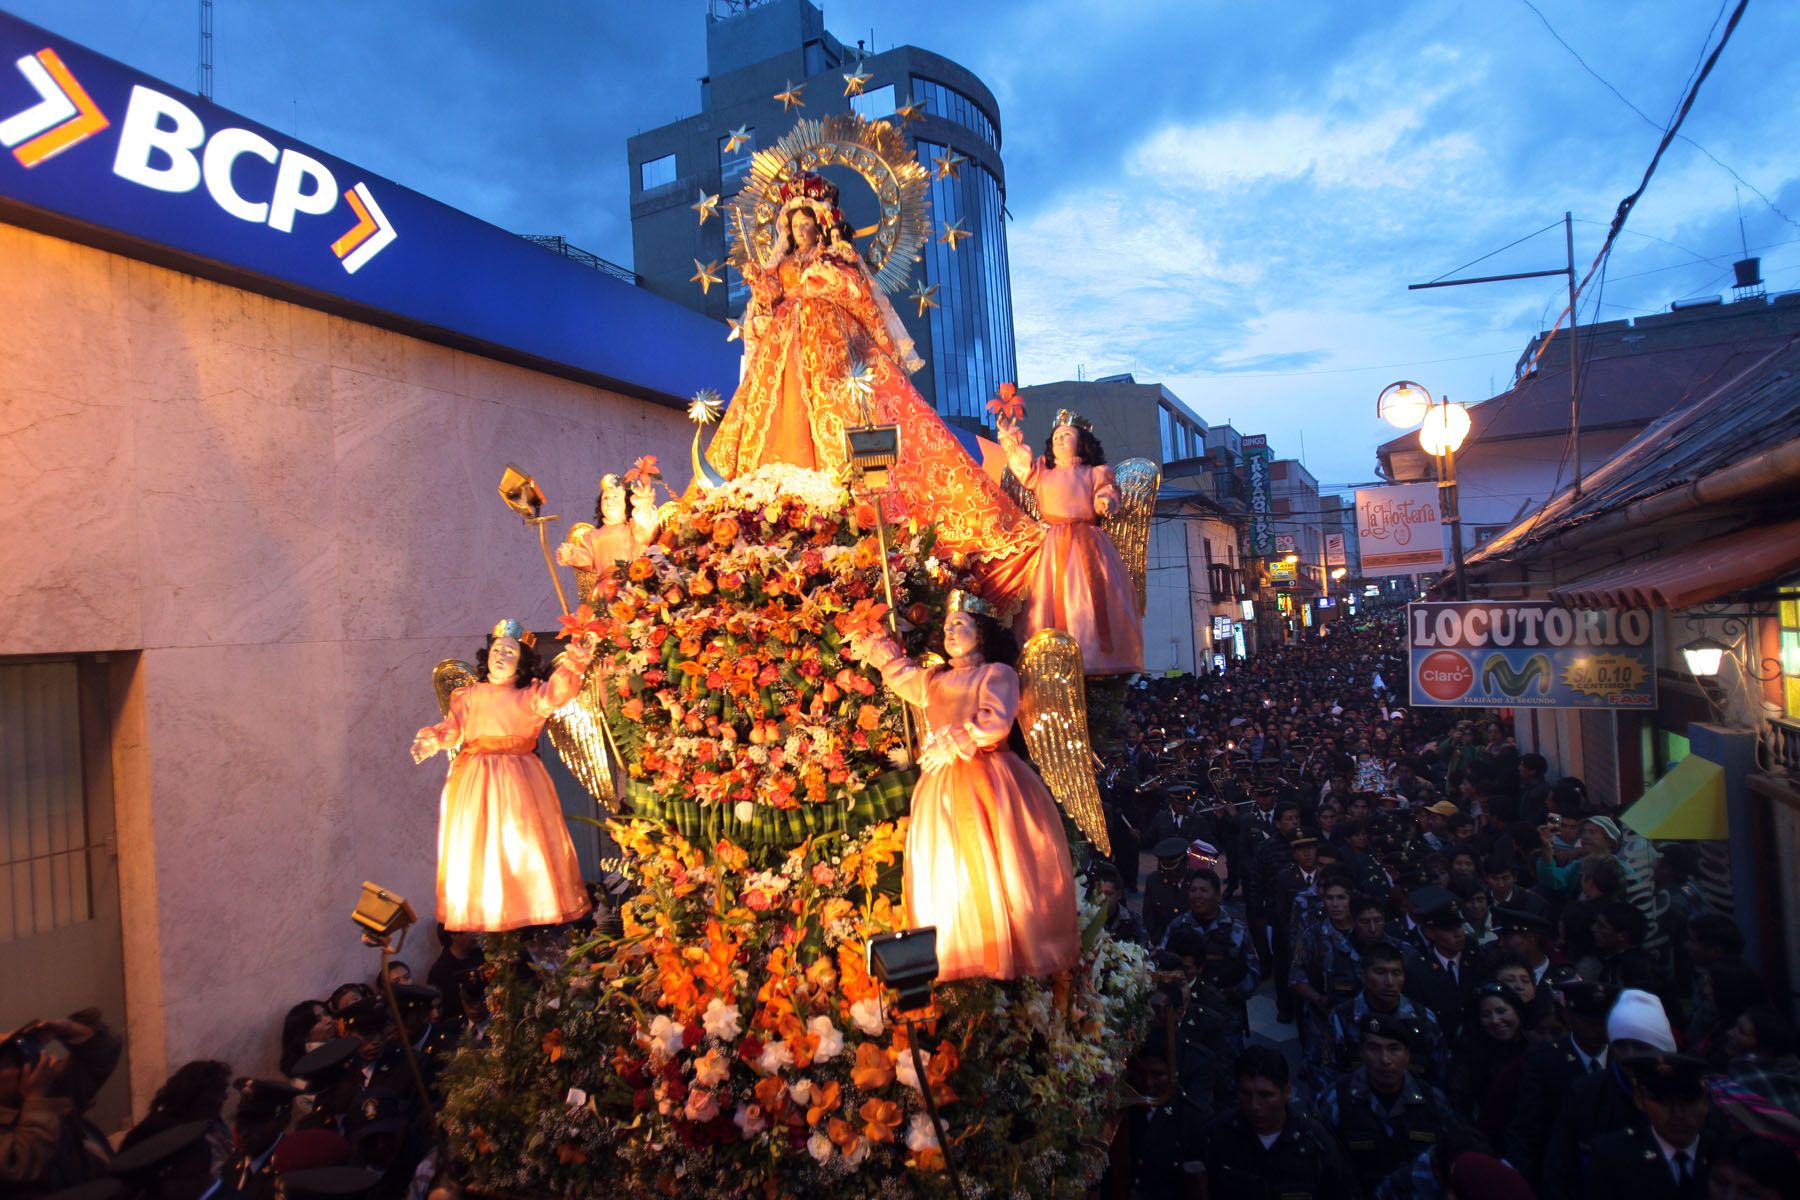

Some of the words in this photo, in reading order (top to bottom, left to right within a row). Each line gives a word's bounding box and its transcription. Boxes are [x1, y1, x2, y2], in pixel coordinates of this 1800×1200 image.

[113, 84, 338, 233] BCP
[1242, 436, 1265, 446] BINGO
[1414, 608, 1650, 647] LOCUTORIO
[1423, 670, 1463, 681] Claro
[1598, 667, 1632, 682] 0.10
[1609, 695, 1650, 704] FAX
